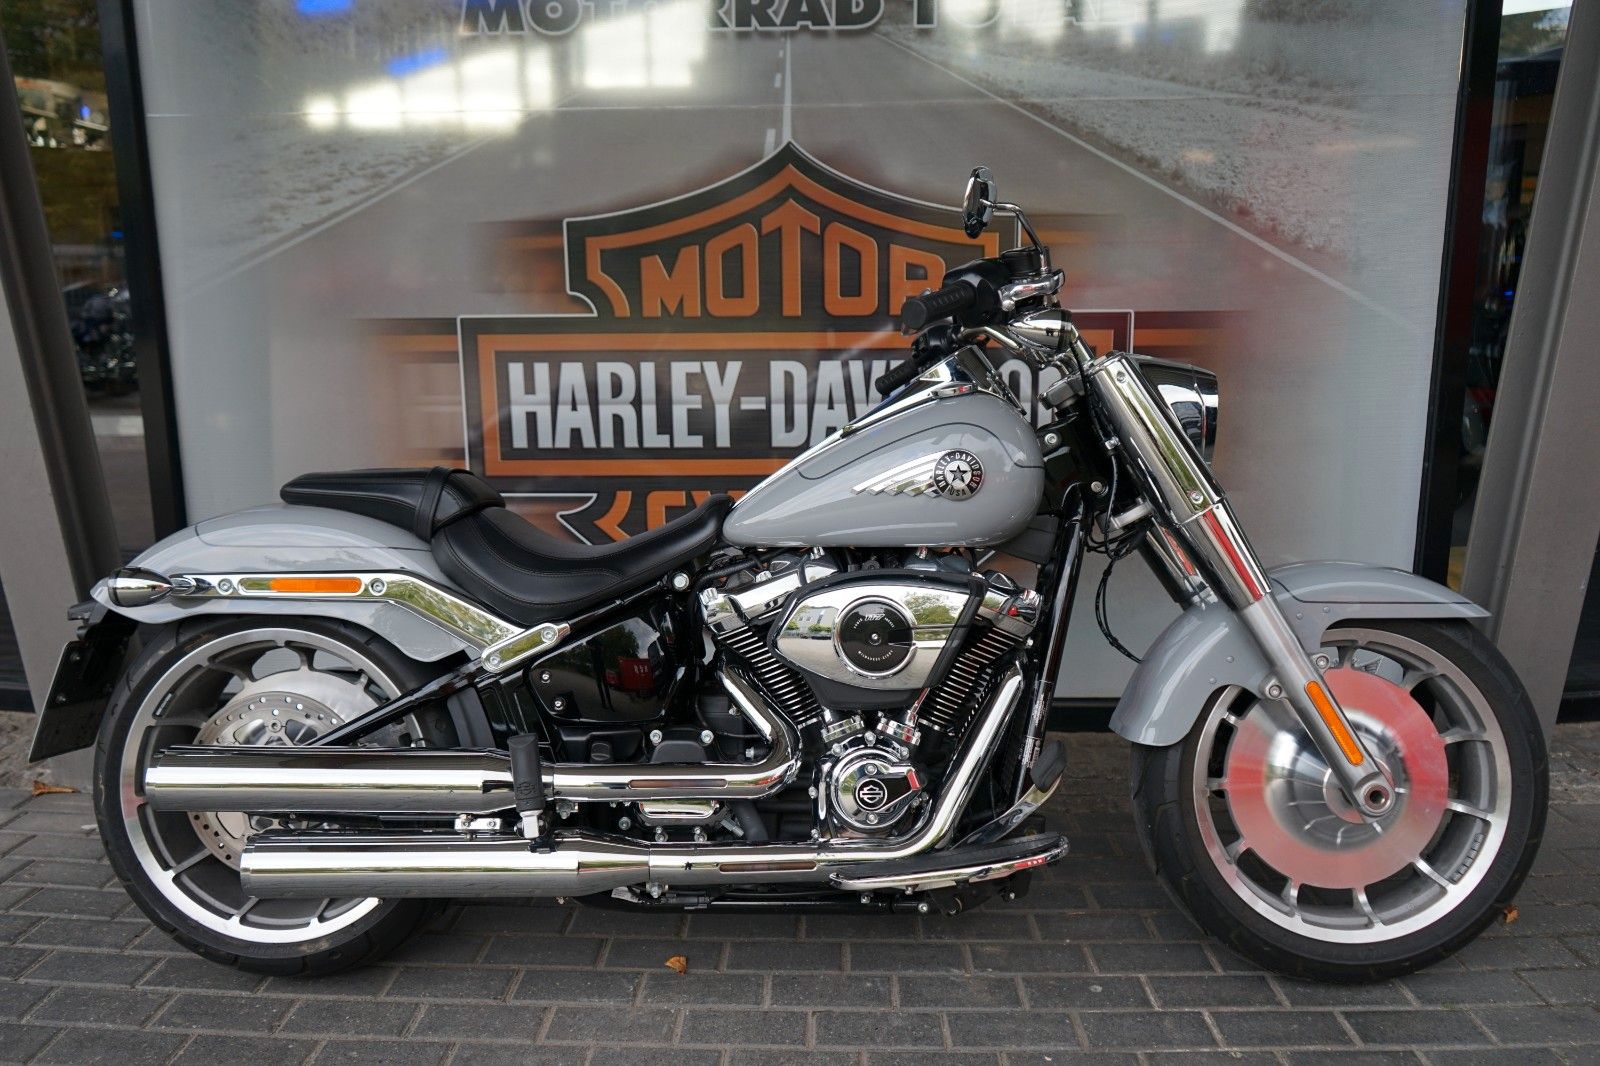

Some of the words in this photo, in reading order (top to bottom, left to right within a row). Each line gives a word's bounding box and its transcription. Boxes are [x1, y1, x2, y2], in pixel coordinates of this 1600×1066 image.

[459, 0, 885, 35] MOTRAD
[935, 452, 982, 488] HARLEY-DAVIDSON
[949, 488, 967, 497] USA
